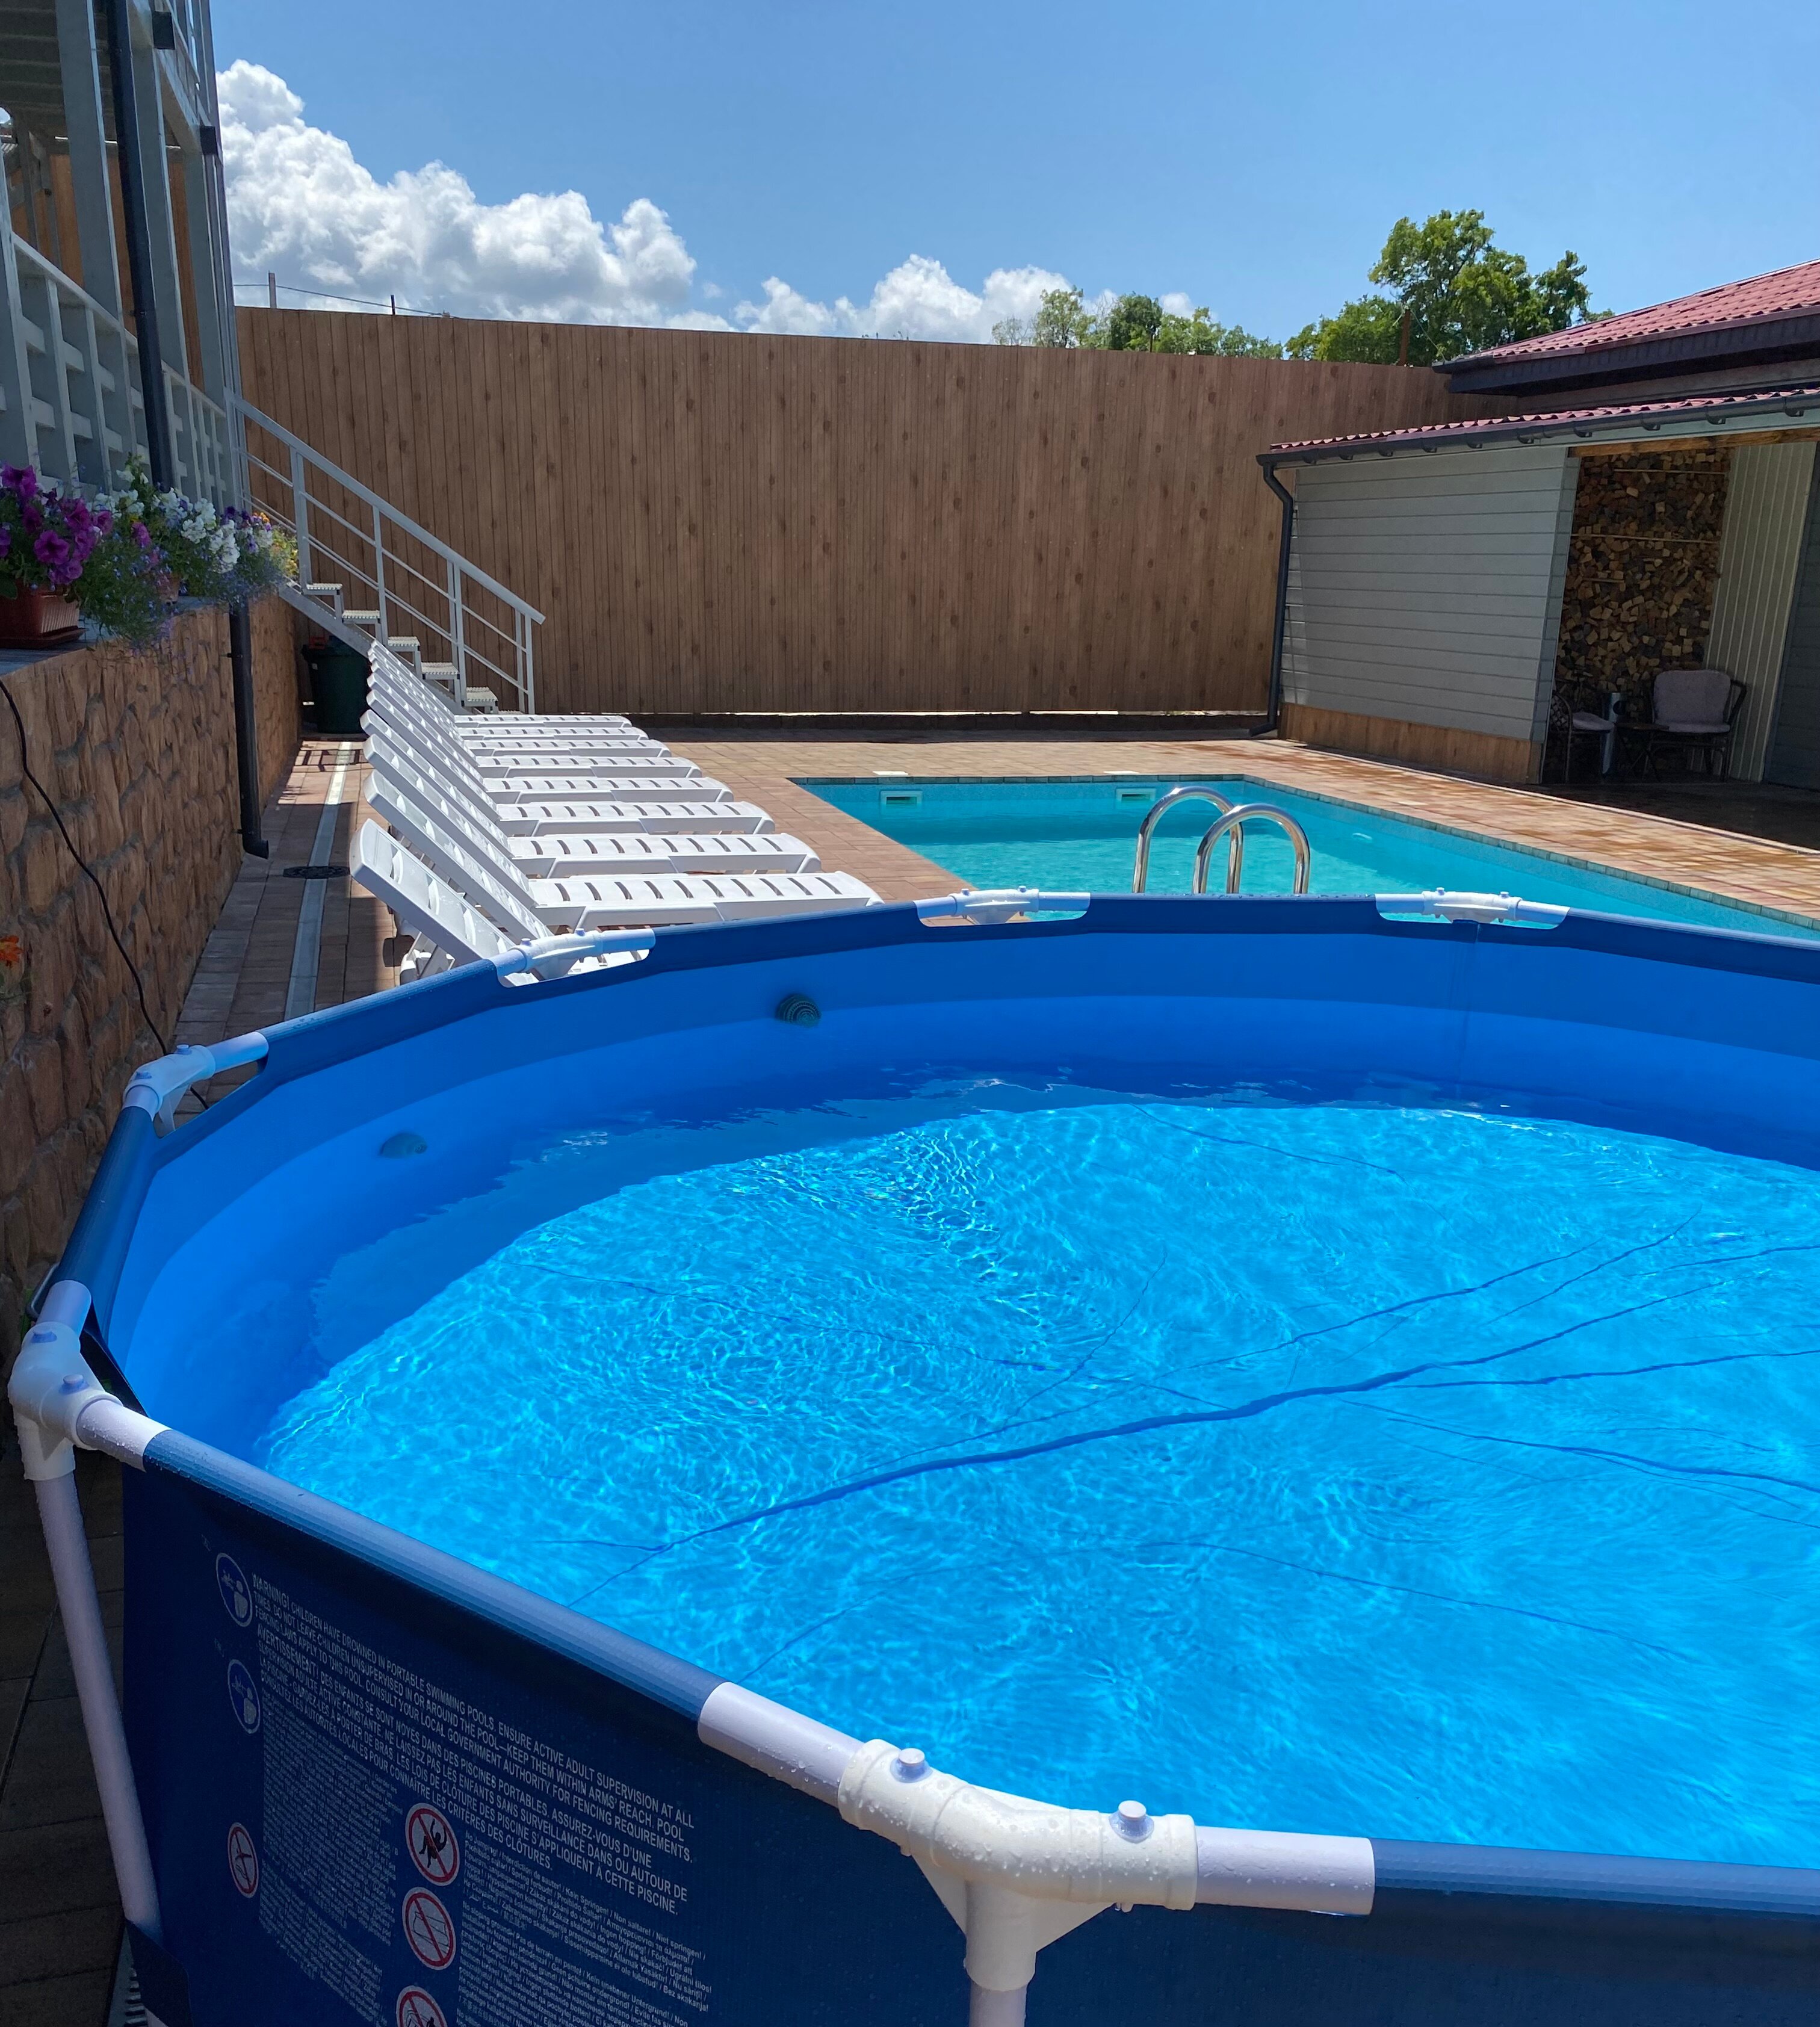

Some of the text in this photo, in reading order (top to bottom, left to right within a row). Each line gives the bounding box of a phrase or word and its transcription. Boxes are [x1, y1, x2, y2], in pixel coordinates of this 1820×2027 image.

[252, 1572, 694, 1828] WARNING! CHILDREN HAVE DROWNED IN PORTABLE SWIMMING POOLS. ENSURE ACTIVE ADULT SUPERVISION AT ALL
[257, 1623, 318, 1680] AVERTISSEMENT!
[320, 1671, 332, 1689] DES
[334, 1680, 364, 1709] ENFANTS
[365, 1700, 373, 1715] SE
[376, 1707, 394, 1728] SONT
[421, 1735, 441, 1757] DANS
[444, 1748, 459, 1767] DES
[460, 1758, 496, 1788] PISCINES
[498, 1779, 549, 1817] PORTABLES.
[551, 1807, 620, 1852] ASSUREZ-VOUS
[623, 1843, 651, 1868] D'UNE
[259, 1655, 266, 1668] LA
[336, 1712, 362, 1739] PORTER
[364, 1731, 373, 1747] DE
[374, 1738, 394, 1760] BRAS.
[397, 1753, 409, 1770] LES
[412, 1762, 427, 1781] LOIS
[430, 1773, 439, 1789] DE
[442, 1777, 477, 1811] CLÔTURE
[479, 1802, 495, 1821] DES
[497, 1812, 528, 1840] PISCINE
[596, 1862, 602, 1878] À
[605, 1869, 634, 1894] CETTE
[637, 1884, 678, 1916] PISCINE.
[273, 1605, 282, 1619] DO
[283, 1611, 295, 1628] NOT
[297, 1620, 316, 1642] LEAVE
[317, 1633, 349, 1663] CHILDREN
[351, 1654, 403, 1697] UNSUPERVISED
[405, 1686, 412, 1700] IN
[414, 1692, 424, 1709] OR
[426, 1698, 457, 1727] AROUND
[460, 1718, 475, 1736] THE
[530, 1756, 554, 1778] THEM
[556, 1769, 587, 1795] WITHIN
[619, 1800, 654, 1827] REACH.
[657, 1818, 684, 1842] POOL
[292, 1695, 303, 1712] LES
[338, 1729, 367, 1759] LOCALES
[370, 1751, 388, 1772] POUR
[432, 1790, 445, 1809] LES
[448, 1798, 485, 1832] CRITÈRES
[488, 1824, 503, 1842] DES
[506, 1831, 552, 1869] CLÔTURES.
[295, 1668, 318, 1693] ADULTE
[319, 1685, 340, 1709] ACTIVE
[342, 1701, 382, 1738] CONSTANTE.
[385, 1729, 394, 1744] NE
[395, 1736, 425, 1763] LAISSEZ
[427, 1755, 440, 1773] PAS
[442, 1764, 457, 1782] LES
[459, 1774, 494, 1804] ENFANTS
[497, 1795, 518, 1817] SANS
[520, 1808, 584, 1852] SURVEILLANCE
[587, 1843, 612, 1866] DANS
[615, 1857, 628, 1874] OU
[631, 1864, 670, 1894] AUTOUR
[674, 1884, 687, 1901] DE
[298, 1635, 317, 1657] APPLY
[319, 1650, 327, 1664] TO
[328, 1655, 342, 1674] THIS
[344, 1666, 364, 1688] POOL.
[366, 1679, 397, 1708] CONSULT
[398, 1699, 419, 1721] YOUR
[421, 1712, 445, 1737] LOCAL
[447, 1727, 501, 1768] GOVERNMENT
[503, 1759, 550, 1794] AUTHORITY
[552, 1784, 570, 1804] FOR
[572, 1795, 611, 1825] FENCING
[614, 1815, 692, 1863] REQUIREMENTS.
[512, 1868, 529, 1885] Spring
[533, 1870, 540, 1880] de
[566, 1887, 578, 1900] Kein
[580, 1895, 608, 1915] Springen!
[614, 1912, 626, 1923] Non
[628, 1920, 650, 1936] saltare!
[656, 1932, 668, 1944] Niet
[670, 1940, 701, 1958] springen!
[570, 1909, 578, 1919] do
[579, 1916, 595, 1928] vody!
[601, 1925, 616, 1939] Ingen
[619, 1934, 646, 1953] hopping!
[684, 1966, 692, 1974] att
[598, 1933, 605, 1943] do
[621, 1966, 630, 1975] ole
[663, 1985, 675, 1996] Bez
[677, 1993, 708, 2011] skakanja!
